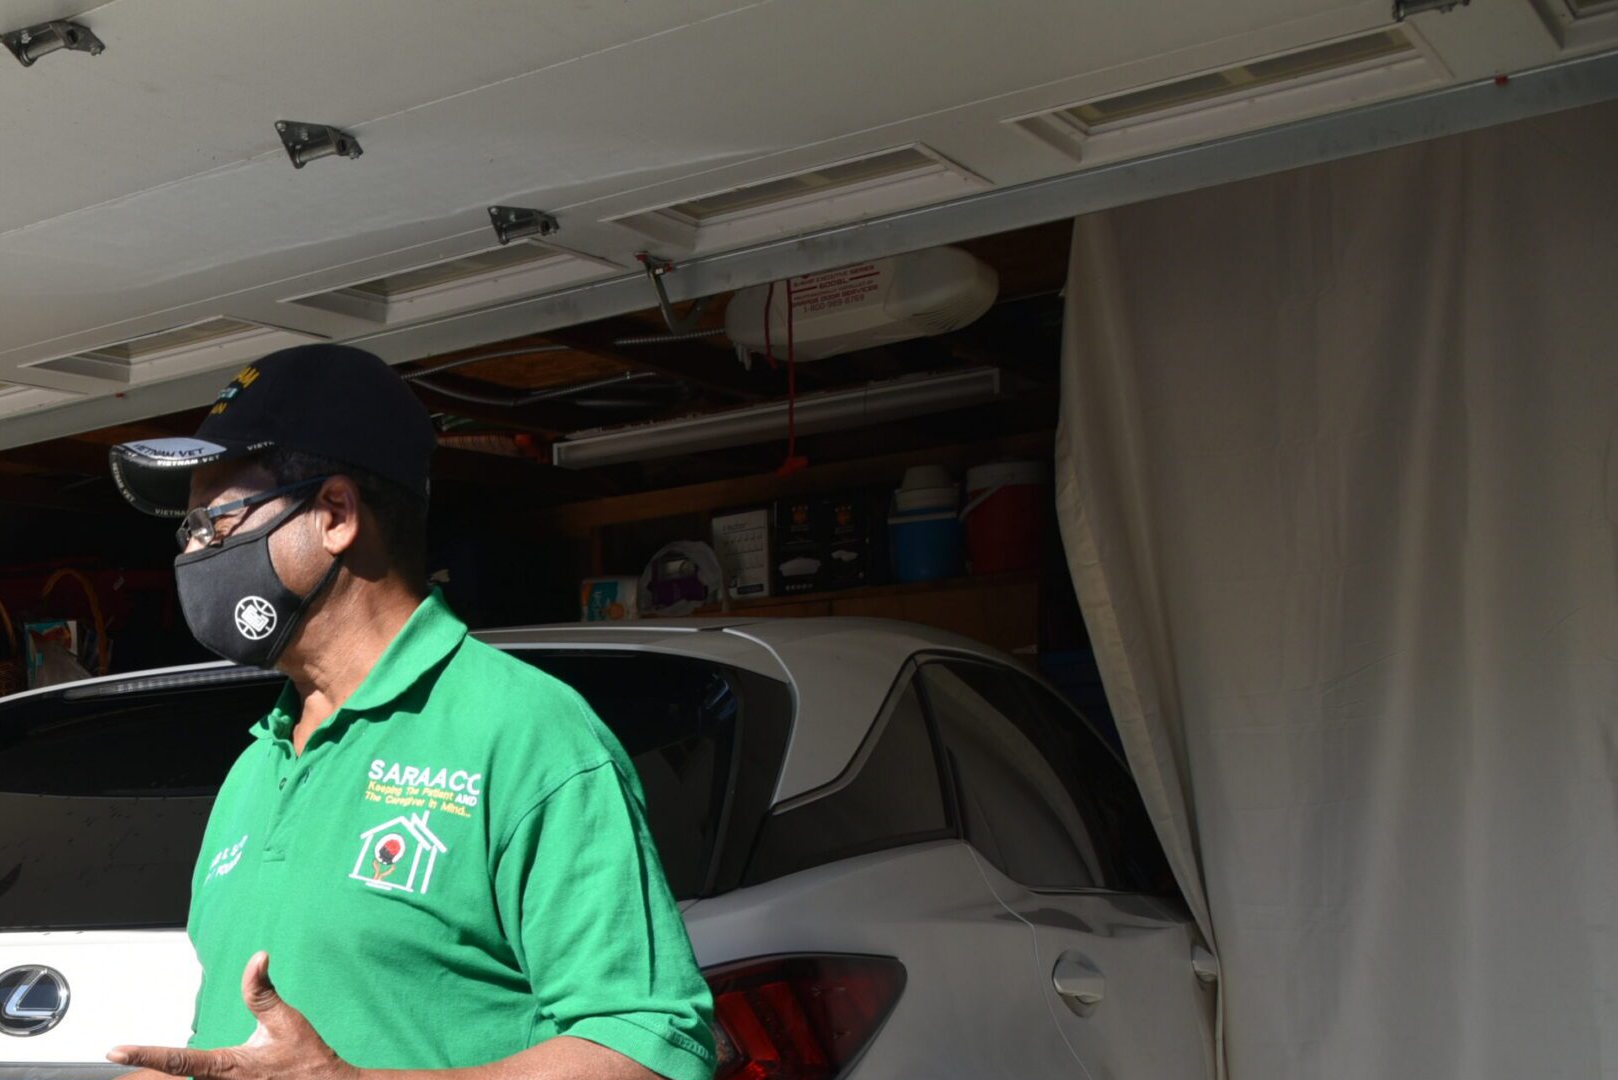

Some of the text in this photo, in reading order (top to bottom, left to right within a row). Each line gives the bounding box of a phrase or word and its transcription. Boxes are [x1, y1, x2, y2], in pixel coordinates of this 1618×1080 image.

[179, 446, 205, 458] VET
[156, 454, 220, 467] VIETNAM VET
[155, 508, 189, 517] VIETNA
[368, 759, 482, 796] SARAACC
[365, 791, 383, 802] The
[385, 795, 426, 808] Caregiver
[368, 780, 402, 796] Keeping
[422, 787, 455, 800] Patient
[455, 793, 478, 807] AND
